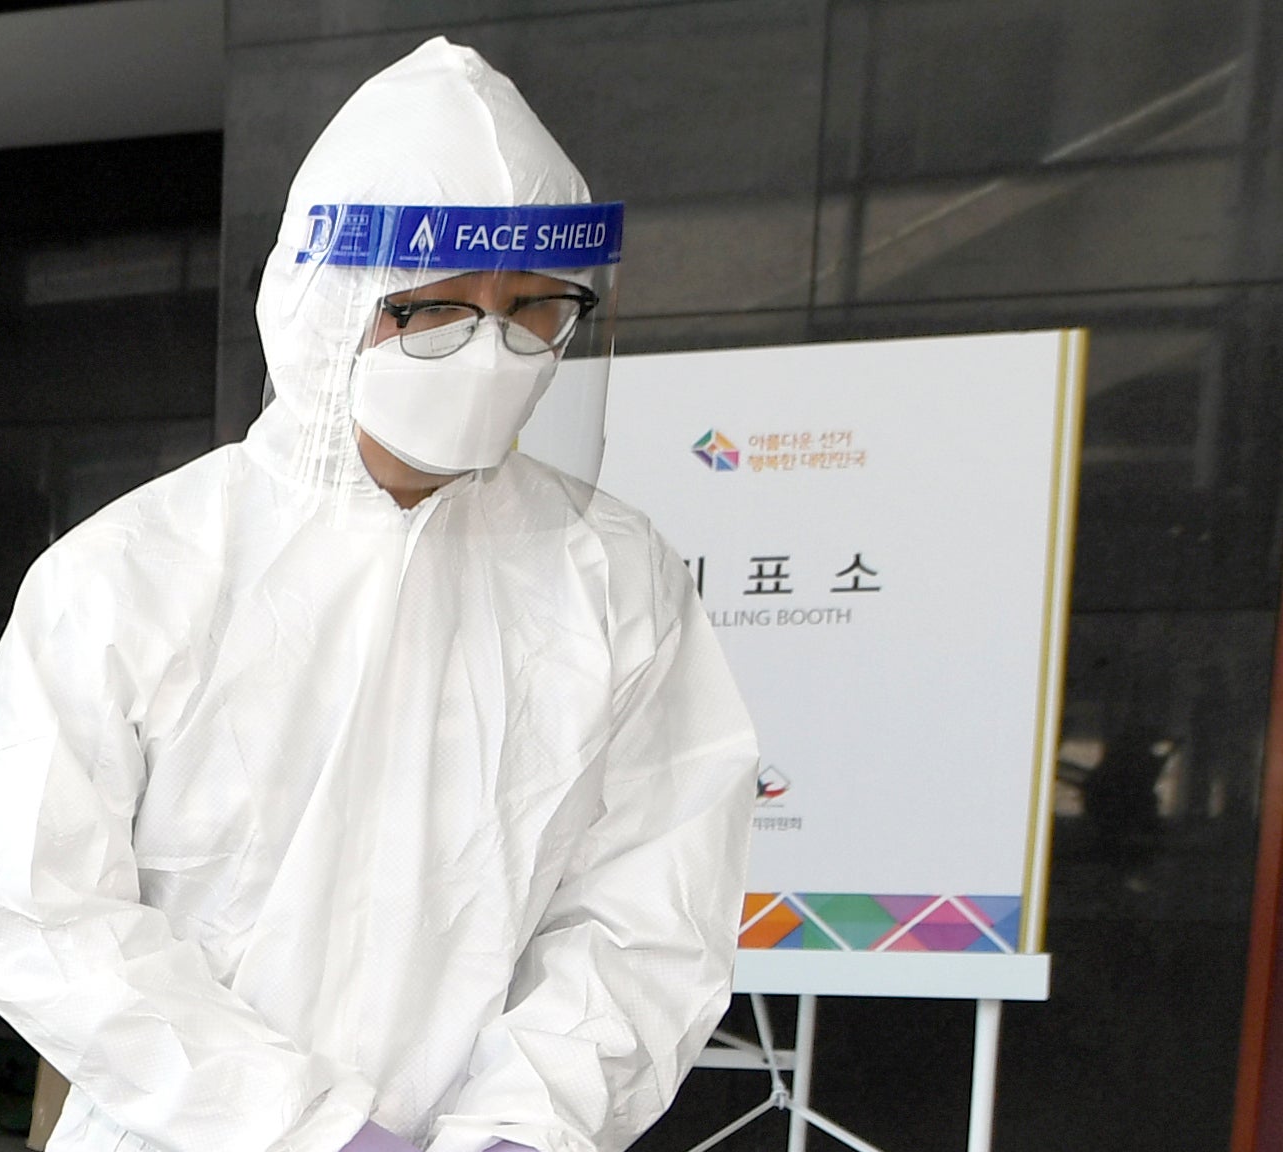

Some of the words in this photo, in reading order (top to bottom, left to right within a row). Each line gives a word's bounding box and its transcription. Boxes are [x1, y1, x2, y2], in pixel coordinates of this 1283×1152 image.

[455, 224, 528, 251] FACE
[534, 222, 606, 250] SHIELD
[748, 431, 813, 450] 아름다운
[819, 430, 853, 449] 선거
[748, 452, 797, 472] 행복한
[801, 450, 867, 469] 대한민국
[707, 609, 770, 628] LLING
[778, 608, 852, 626] BOOTH
